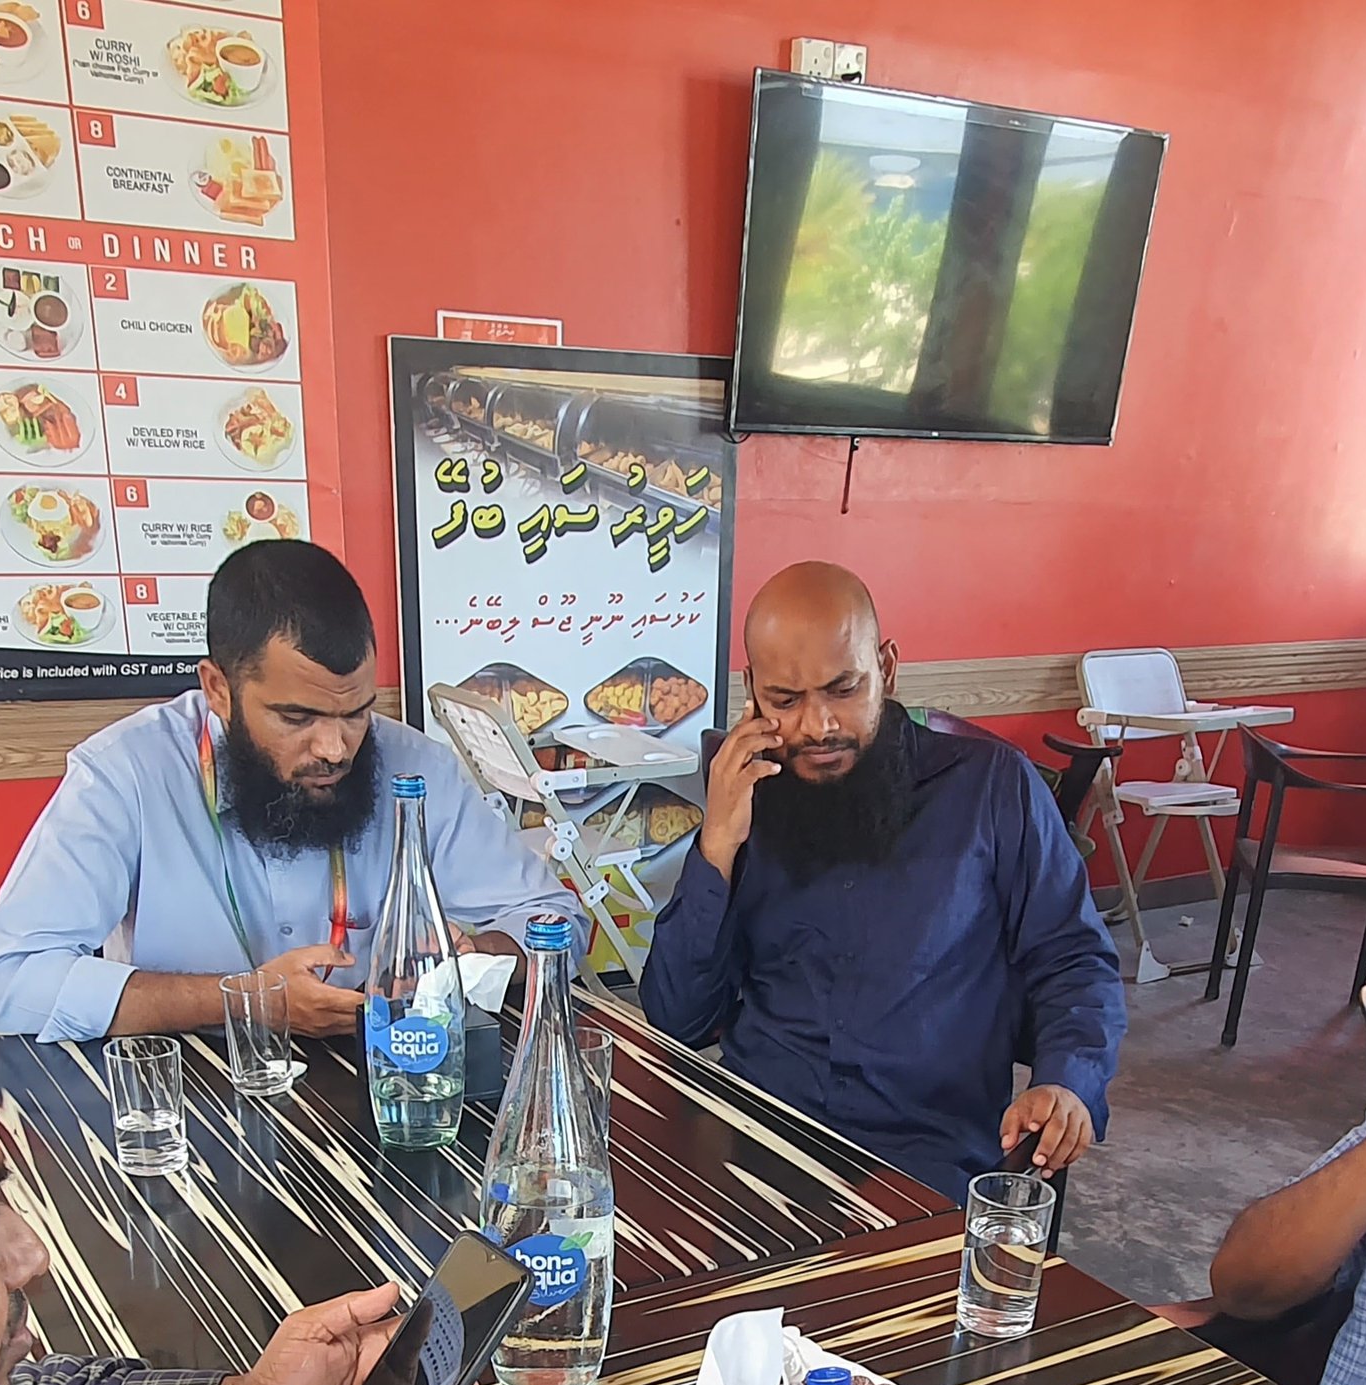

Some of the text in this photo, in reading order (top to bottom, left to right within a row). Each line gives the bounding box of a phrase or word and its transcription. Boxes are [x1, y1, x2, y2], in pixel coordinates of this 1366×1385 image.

[76, 0, 91, 20] 6
[95, 38, 133, 53] CURRY
[106, 52, 140, 67] ROSHI
[89, 119, 103, 139] 8
[106, 165, 175, 184] CONTINENTAL
[112, 178, 170, 194] BREAKFAST
[67, 235, 83, 251] OR
[102, 233, 258, 271] DINNER
[104, 273, 117, 291] 2
[120, 319, 193, 334] CHILI CHICKEN
[115, 382, 127, 400] 4
[132, 426, 198, 439] DEVILED FISH
[140, 438, 181, 449] YELLOW
[183, 439, 206, 450] RICE
[125, 485, 139, 502] 6
[141, 522, 175, 533] CURRY
[190, 523, 213, 533] RICE
[135, 583, 148, 600] 8
[146, 612, 198, 621] VEGETABLE
[22, 666, 34, 679] is
[36, 665, 90, 678] included
[92, 664, 117, 677] with
[120, 663, 148, 676] GST
[150, 663, 174, 675] and
[176, 662, 199, 674] Ser
[390, 1025, 437, 1043] bon-
[390, 1041, 440, 1059] aqua
[533, 1269, 577, 1291] qua
